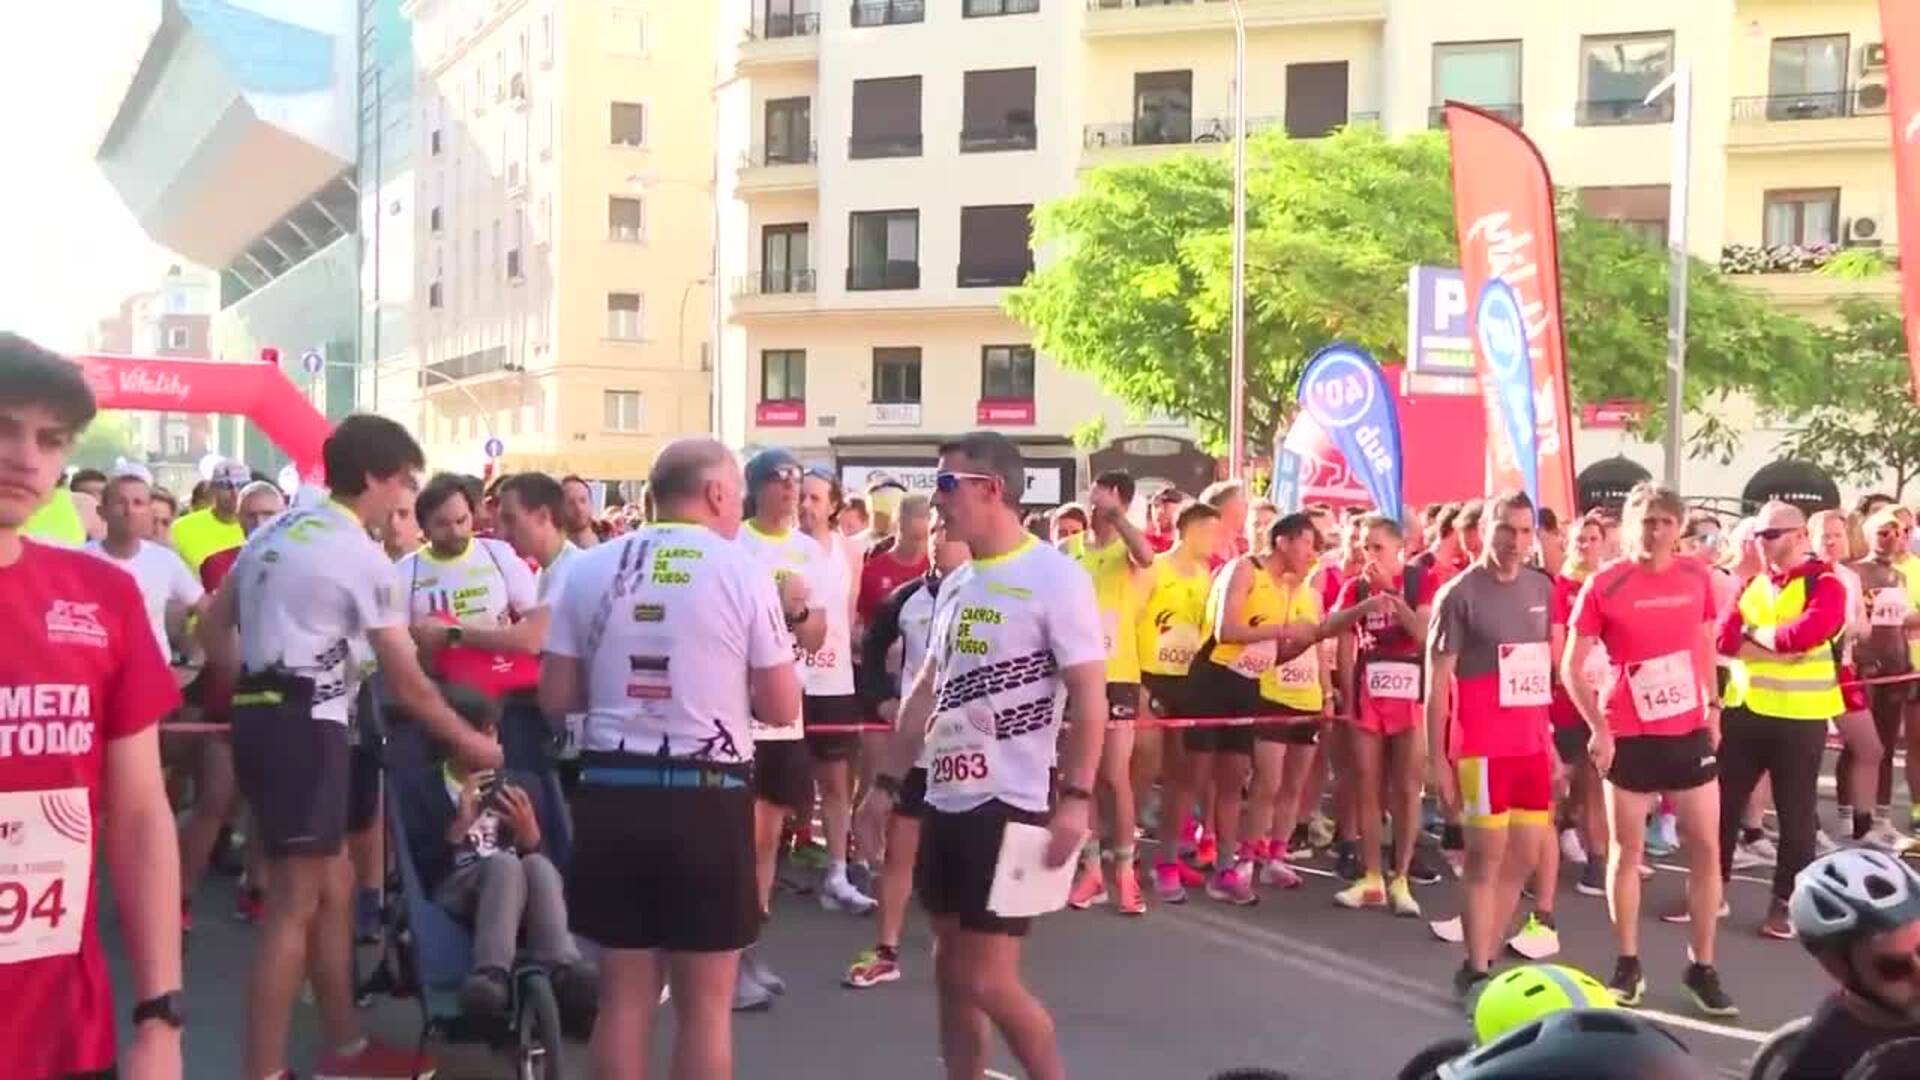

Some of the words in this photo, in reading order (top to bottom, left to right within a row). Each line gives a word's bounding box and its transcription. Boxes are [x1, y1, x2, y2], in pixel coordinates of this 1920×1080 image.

[120, 368, 191, 401] Vitality
[652, 572, 690, 584] FUEGO
[1370, 672, 1413, 690] 6207
[0, 684, 90, 719] META
[0, 721, 95, 757] TODOS
[932, 753, 988, 784] 2963
